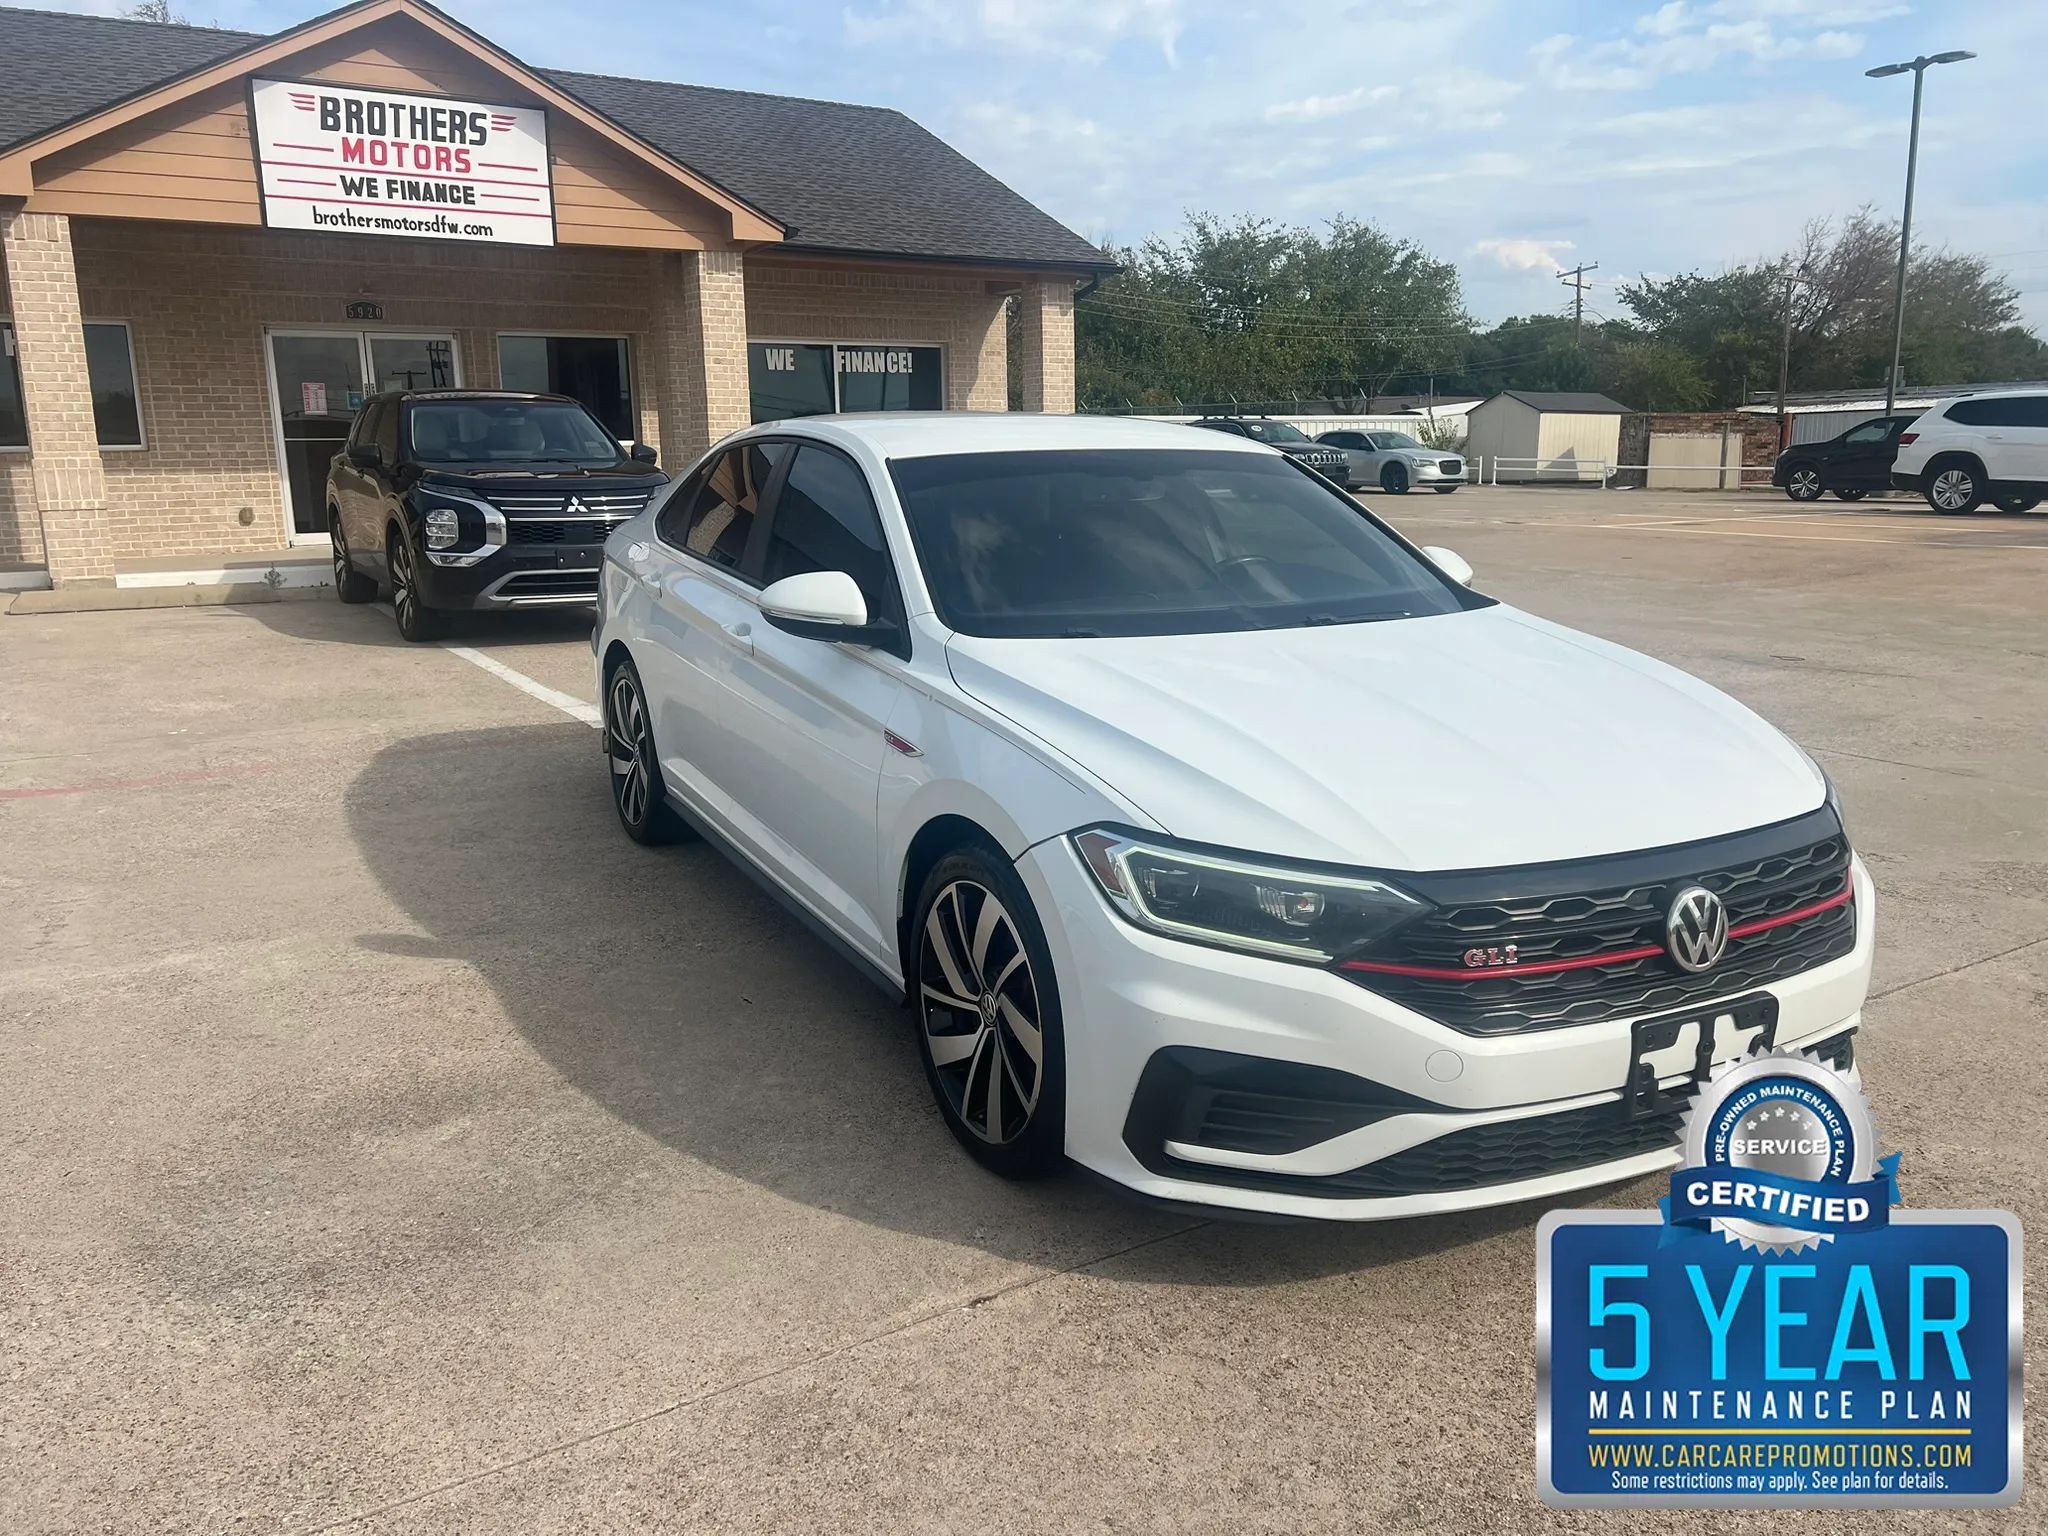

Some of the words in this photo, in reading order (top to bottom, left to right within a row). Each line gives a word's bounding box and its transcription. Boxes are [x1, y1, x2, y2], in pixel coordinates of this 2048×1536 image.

[320, 95, 488, 146] BROTHERS
[342, 137, 471, 173] MOTORS
[339, 174, 379, 198] WE
[386, 178, 476, 205] FINANCE
[312, 205, 494, 236] brothersmotorsdfw.com
[347, 305, 382, 319] 5920
[765, 349, 795, 371] WE
[837, 351, 913, 374] FINANCE!
[1464, 944, 1518, 967] GLI
